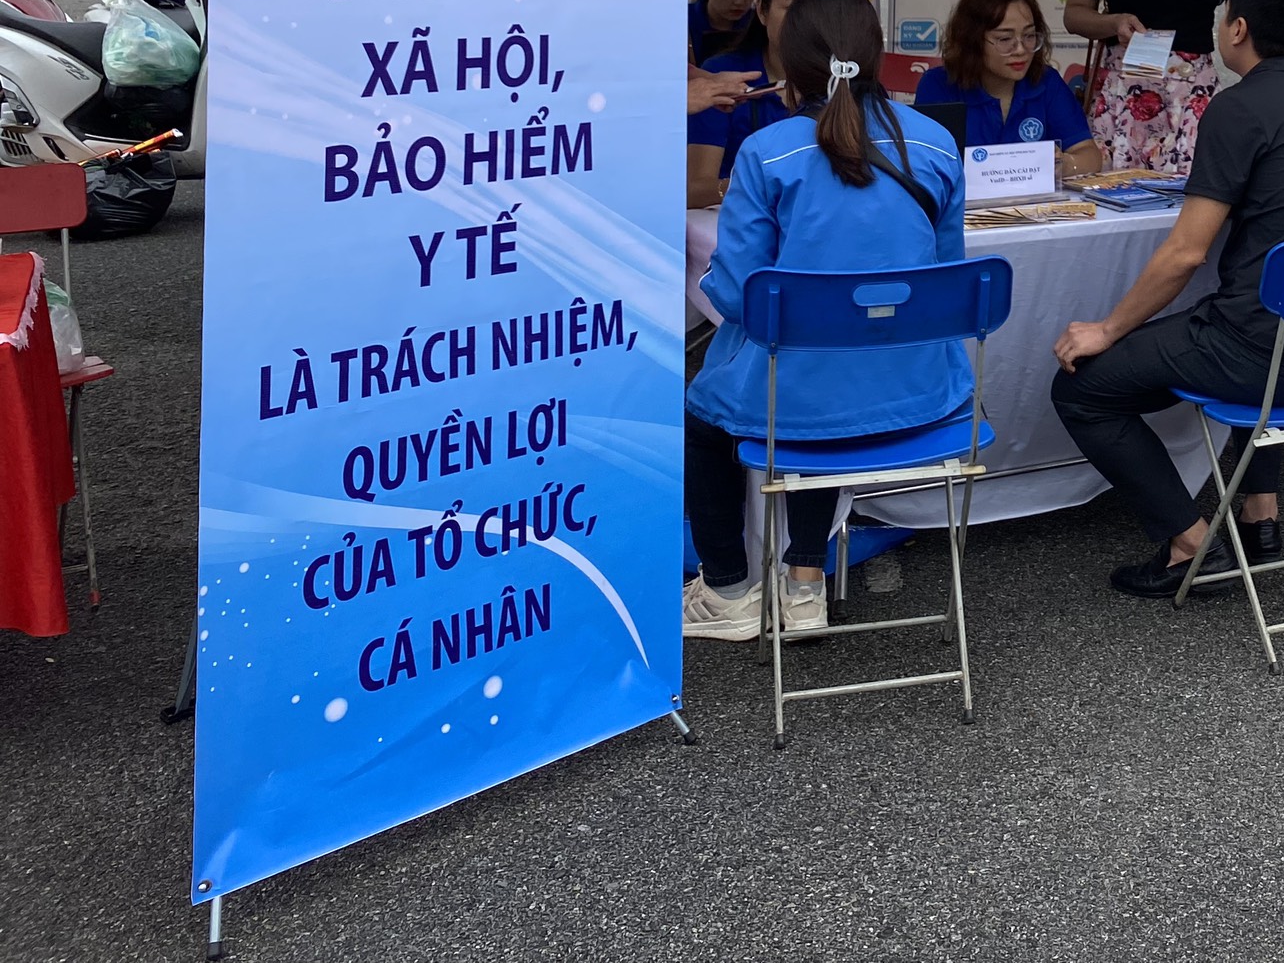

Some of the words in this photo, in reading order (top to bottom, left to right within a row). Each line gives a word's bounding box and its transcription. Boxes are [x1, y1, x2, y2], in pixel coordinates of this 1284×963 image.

[361, 26, 439, 98] XÃ
[456, 24, 565, 103] HỘI,
[324, 122, 446, 202] BẢO
[463, 106, 593, 185] HIỂM
[408, 231, 445, 287] Y
[456, 203, 522, 280] TẾ
[259, 348, 318, 421] LÀ
[331, 326, 476, 403] TRÁCH
[492, 297, 639, 371] NHIỆM,
[342, 409, 492, 503] QUYỀN
[507, 397, 568, 466] LỢI
[302, 532, 396, 610] CỦA
[408, 499, 464, 579] TỔ
[475, 482, 598, 558] CHỨC,
[358, 617, 418, 692] CÁ
[432, 584, 551, 671] NHÂN
